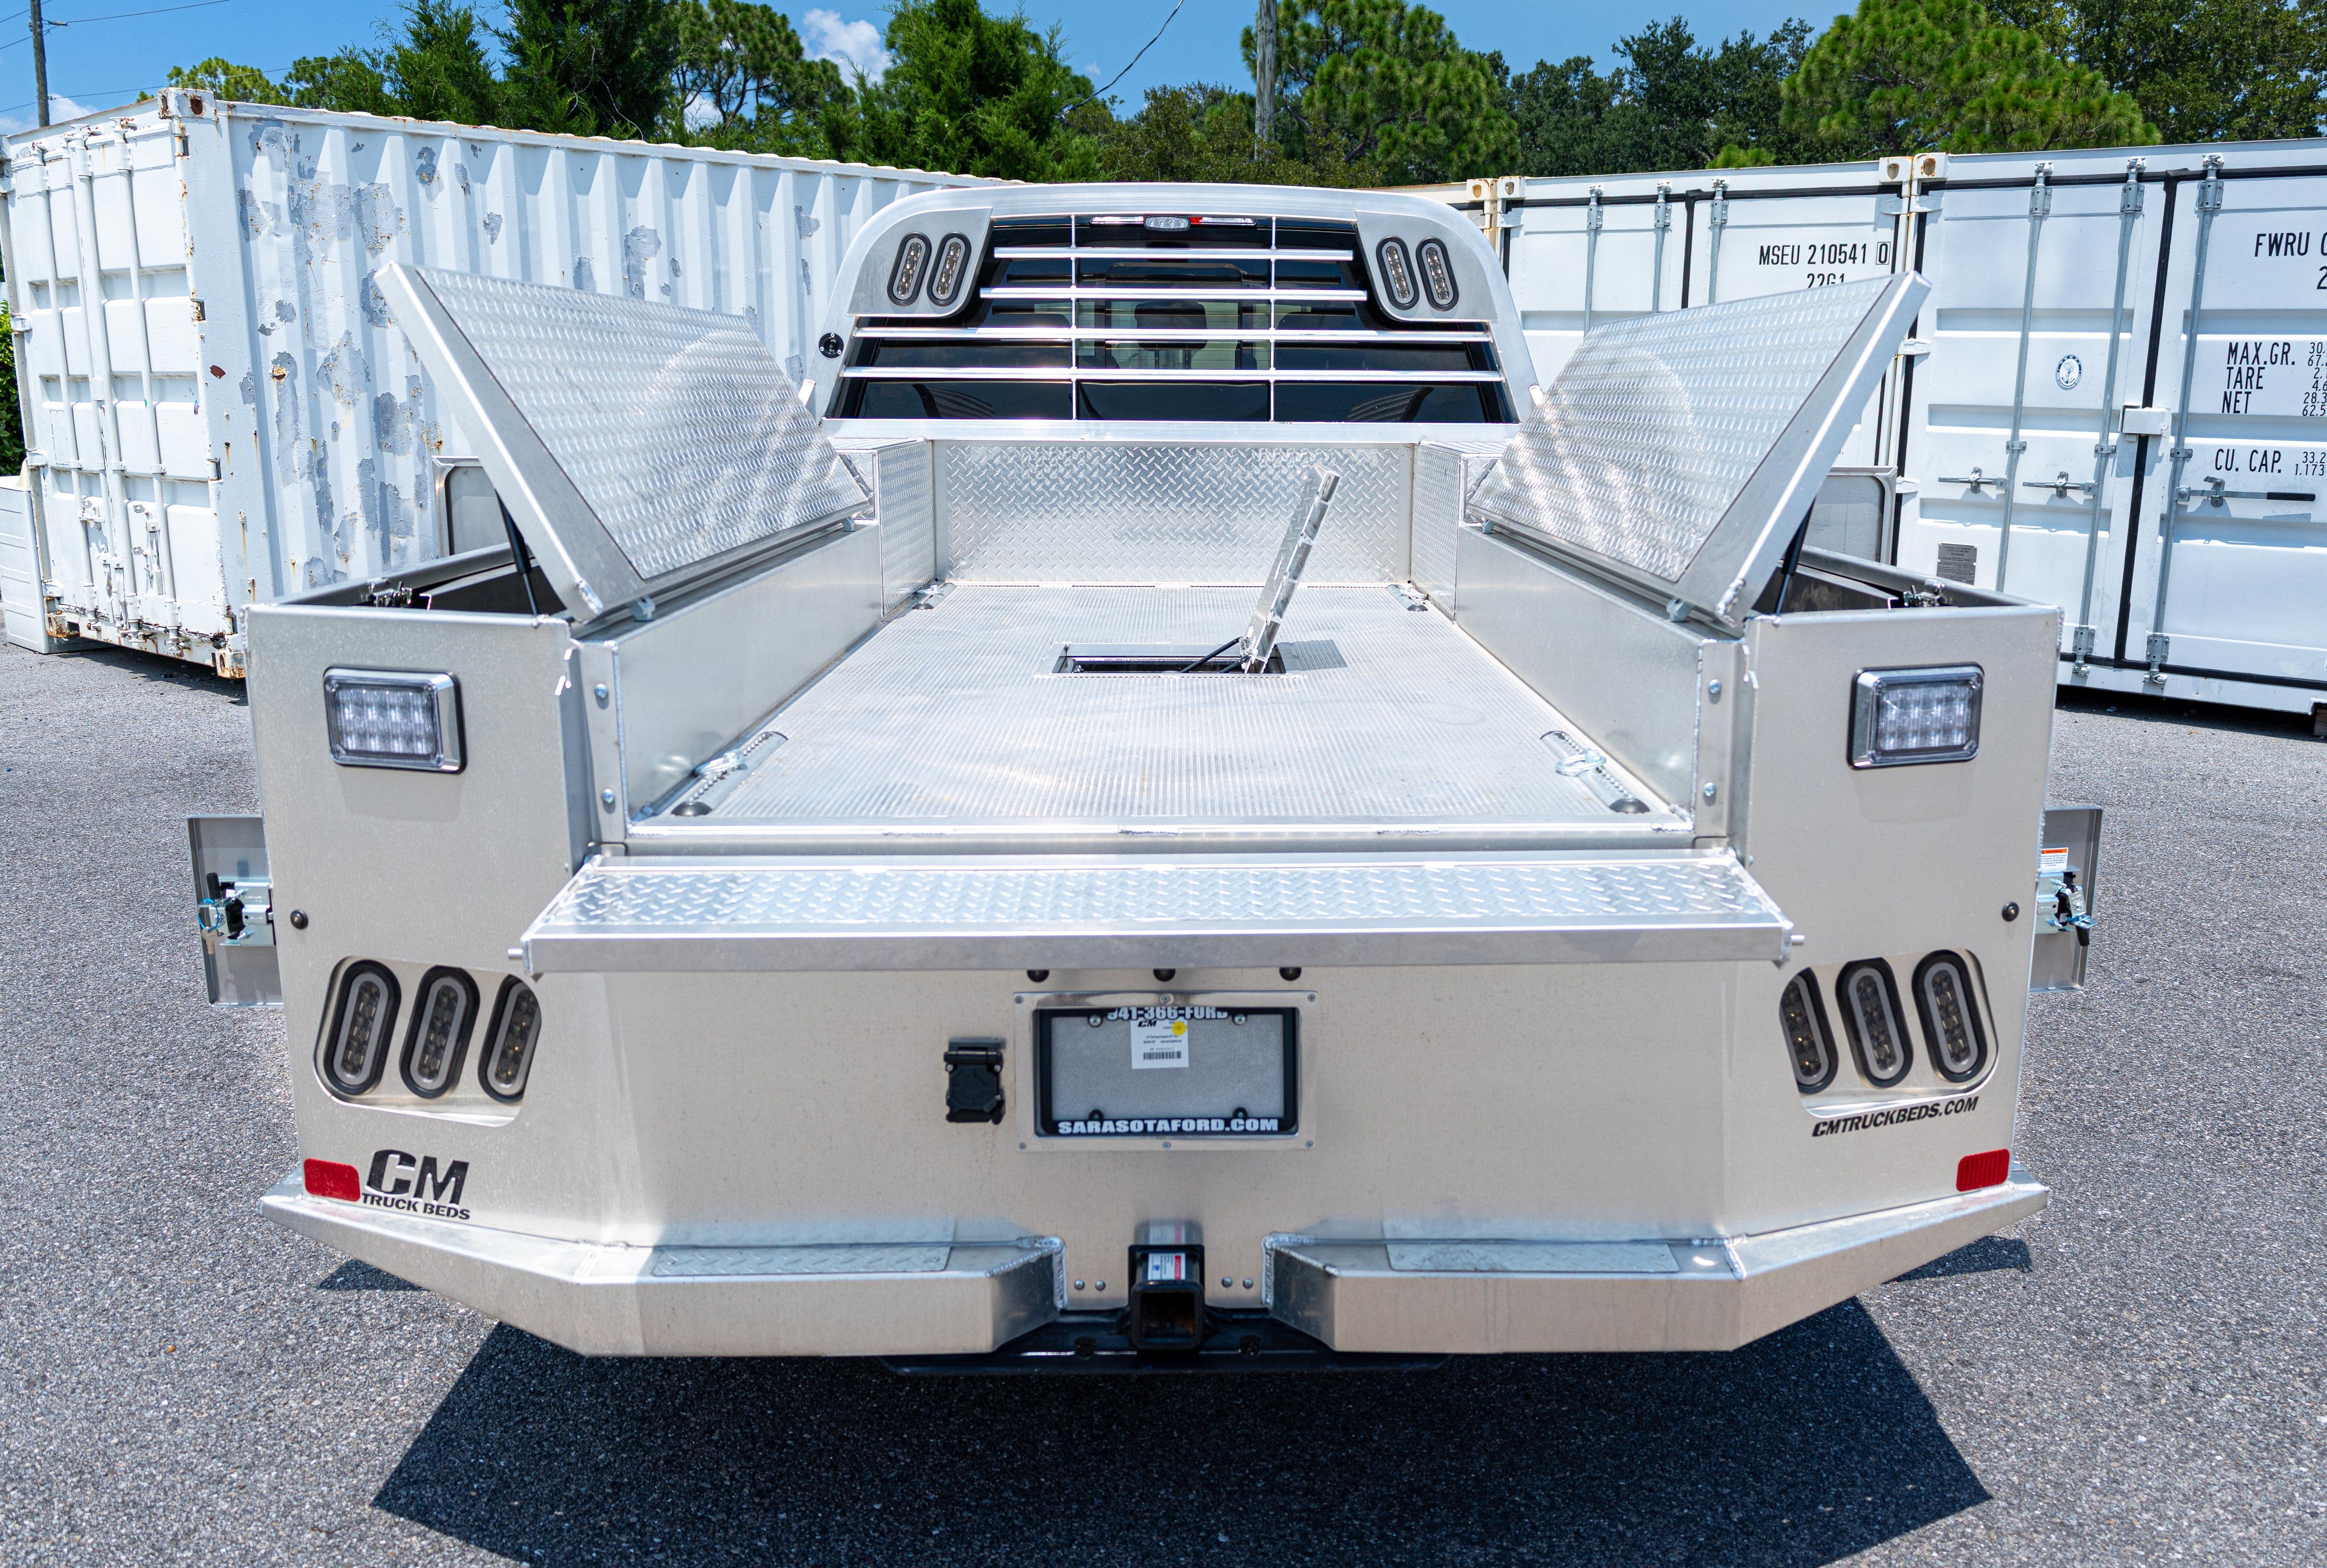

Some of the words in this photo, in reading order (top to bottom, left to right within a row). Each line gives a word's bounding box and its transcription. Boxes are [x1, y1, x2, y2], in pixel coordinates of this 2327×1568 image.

[1759, 245, 1800, 265] MSEU
[1807, 243, 1867, 265] 210541
[2254, 232, 2310, 257] FWRU
[2226, 366, 2265, 389] TARE
[2222, 391, 2252, 414] NET
[2215, 448, 2239, 472] CU.
[2249, 449, 2282, 473] CAP.
[1058, 1119, 1278, 1134] SARASOTAFORD.COM
[1812, 1096, 1979, 1137] CMTRUCKBEDS.COM
[366, 1149, 469, 1206] CM
[362, 1193, 418, 1212] TRUCK
[423, 1203, 470, 1220] BEDS
